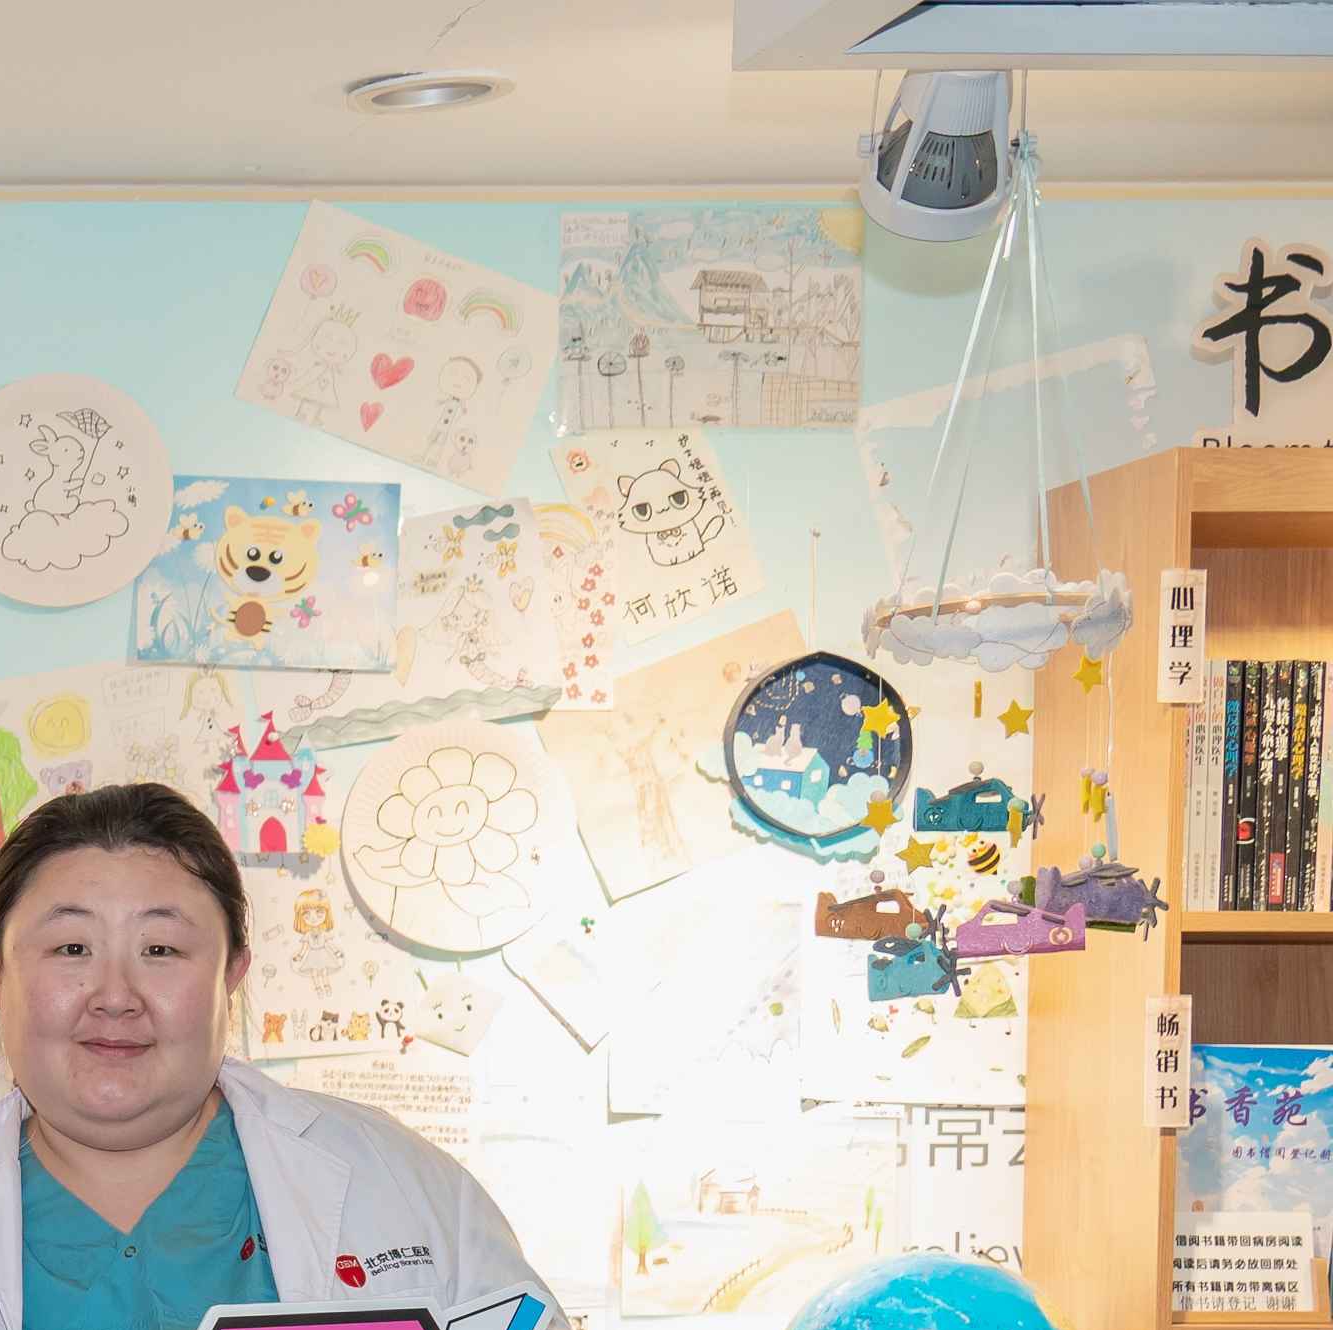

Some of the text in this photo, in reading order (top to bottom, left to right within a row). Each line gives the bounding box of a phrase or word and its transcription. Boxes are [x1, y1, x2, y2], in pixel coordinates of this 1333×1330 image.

[1168, 586, 1196, 687] 心理学
[1154, 1012, 1180, 1111] 畅销书
[1175, 1234, 1303, 1247] 借阅书籍带回病房阅读
[1172, 1257, 1299, 1270] 阅读后请务必放回原处
[1172, 1280, 1300, 1293] 所有书籍请勿带离病区
